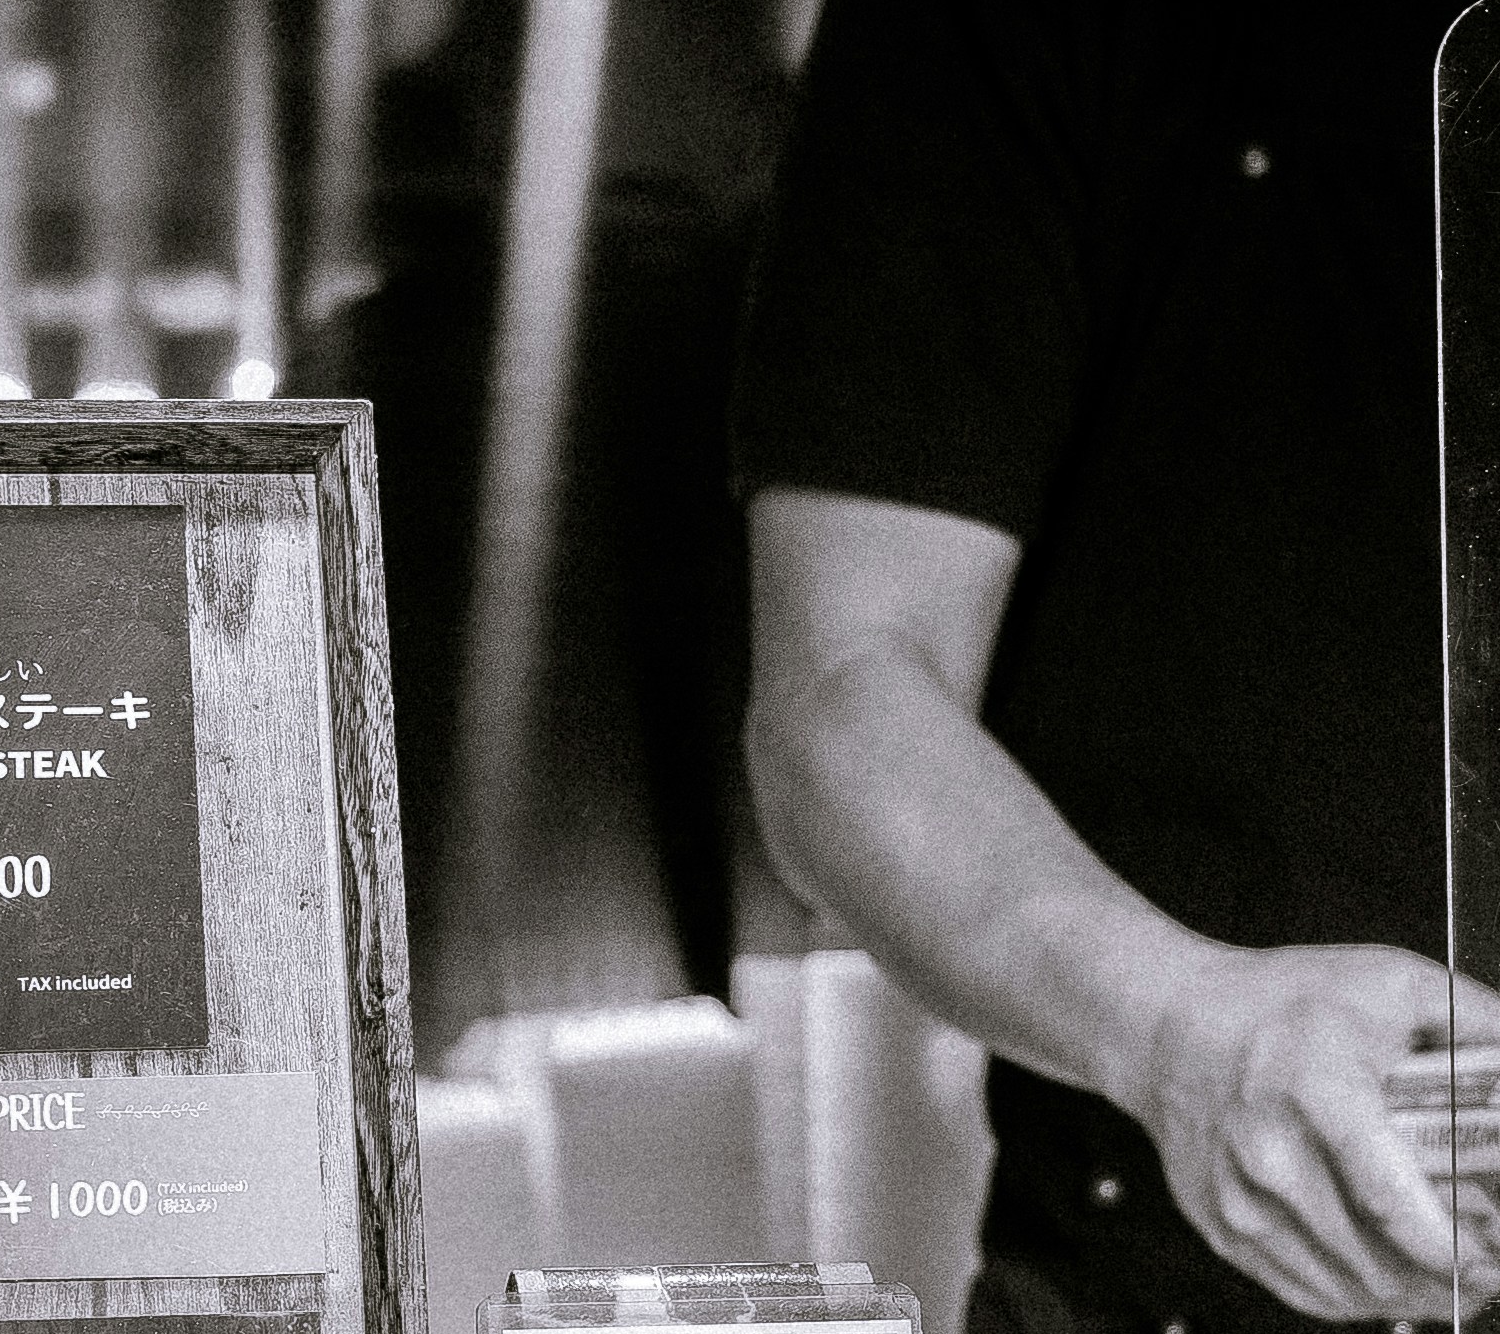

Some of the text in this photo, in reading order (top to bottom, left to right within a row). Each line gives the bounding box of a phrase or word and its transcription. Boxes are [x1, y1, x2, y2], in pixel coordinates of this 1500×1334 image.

[17, 971, 133, 993] TAX included
[157, 1179, 249, 1197] (TAX included)
